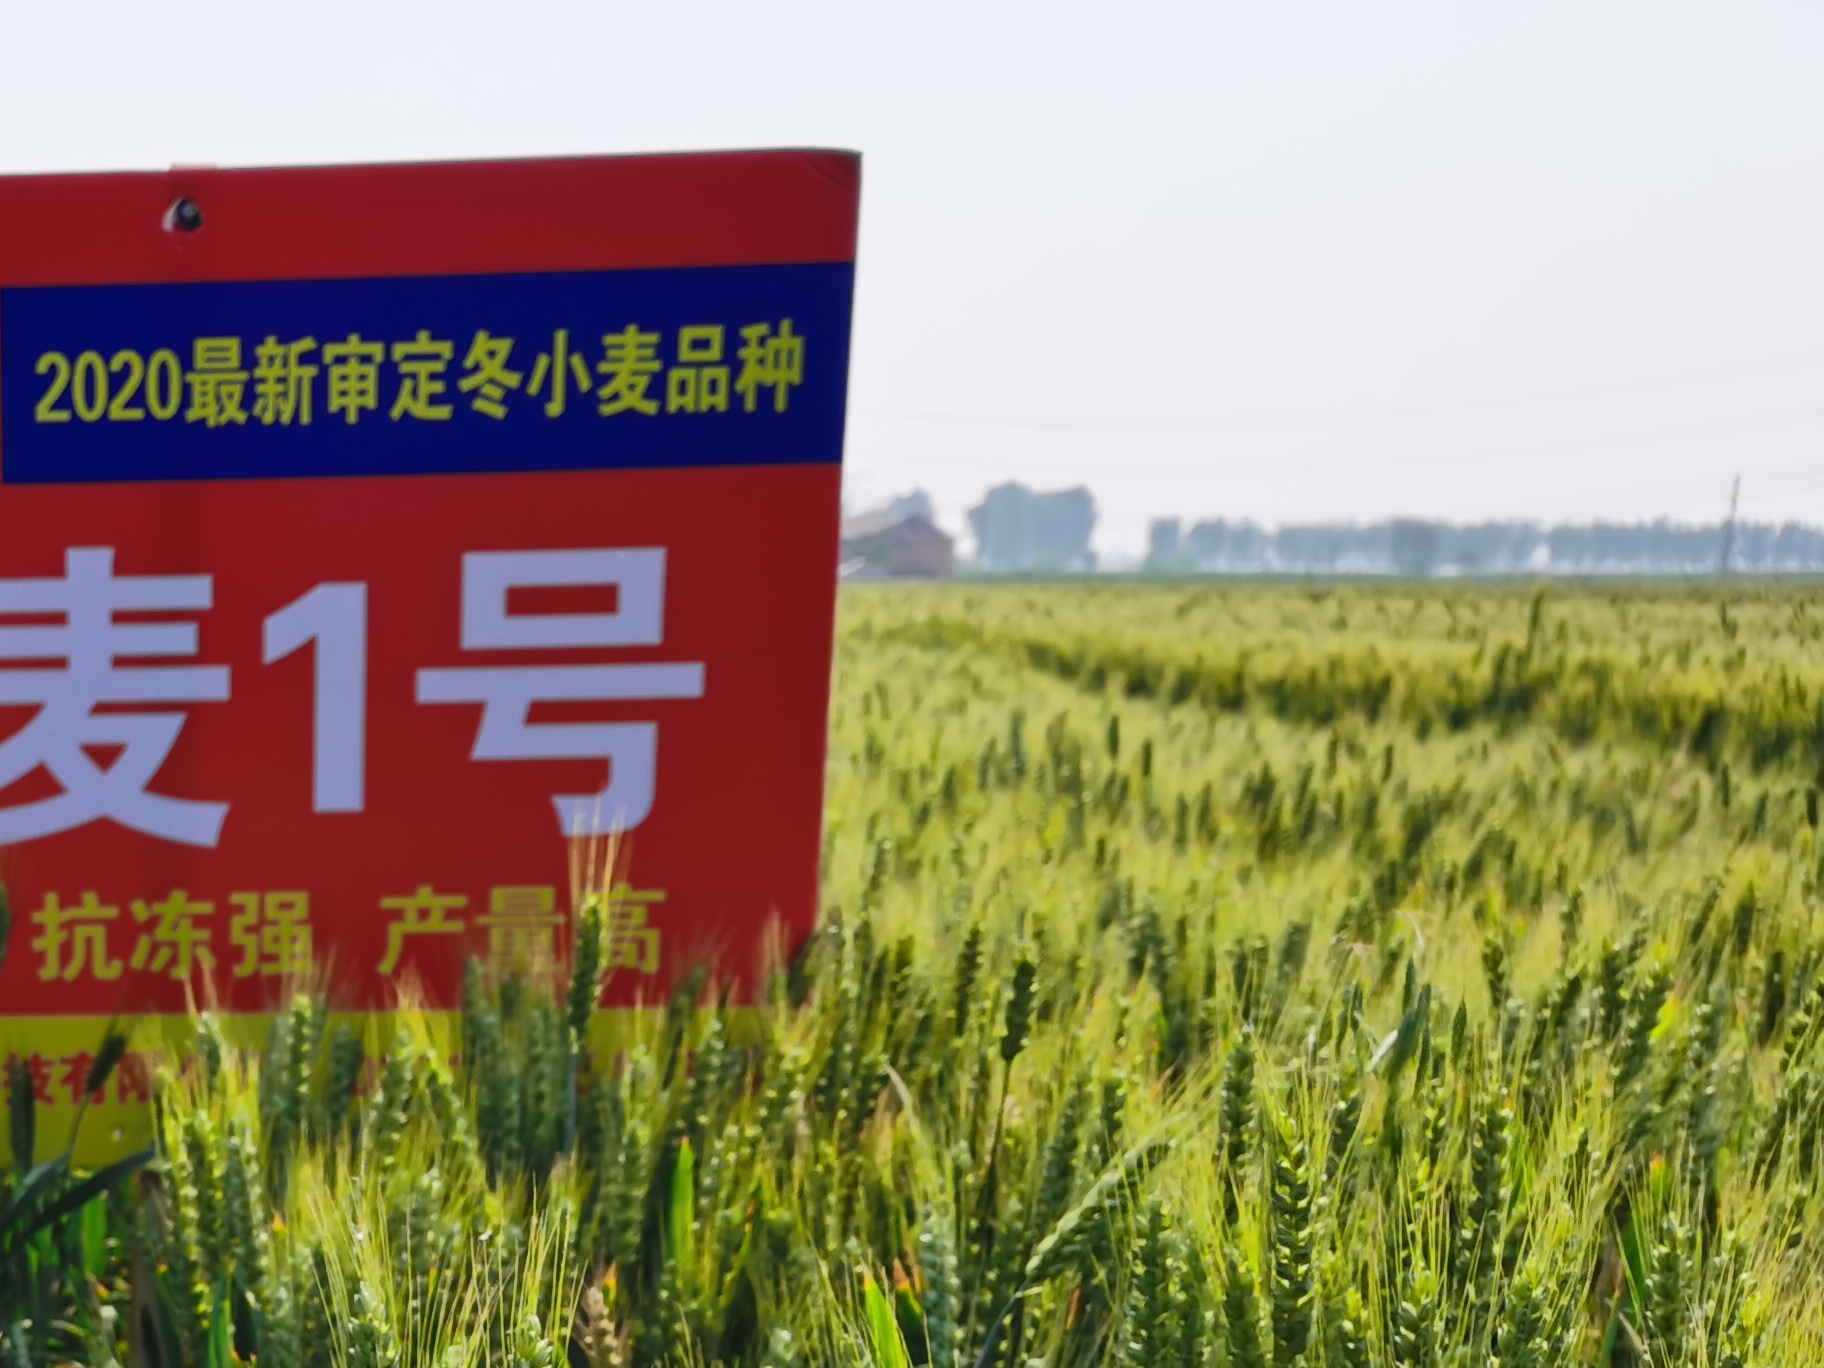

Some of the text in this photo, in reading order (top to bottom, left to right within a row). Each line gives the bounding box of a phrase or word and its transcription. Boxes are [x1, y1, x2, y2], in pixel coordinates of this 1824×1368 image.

[33, 319, 804, 427] 2020最新审定冬小麦品种
[31, 890, 314, 982] 抗冻强
[377, 882, 666, 976] 产量高
